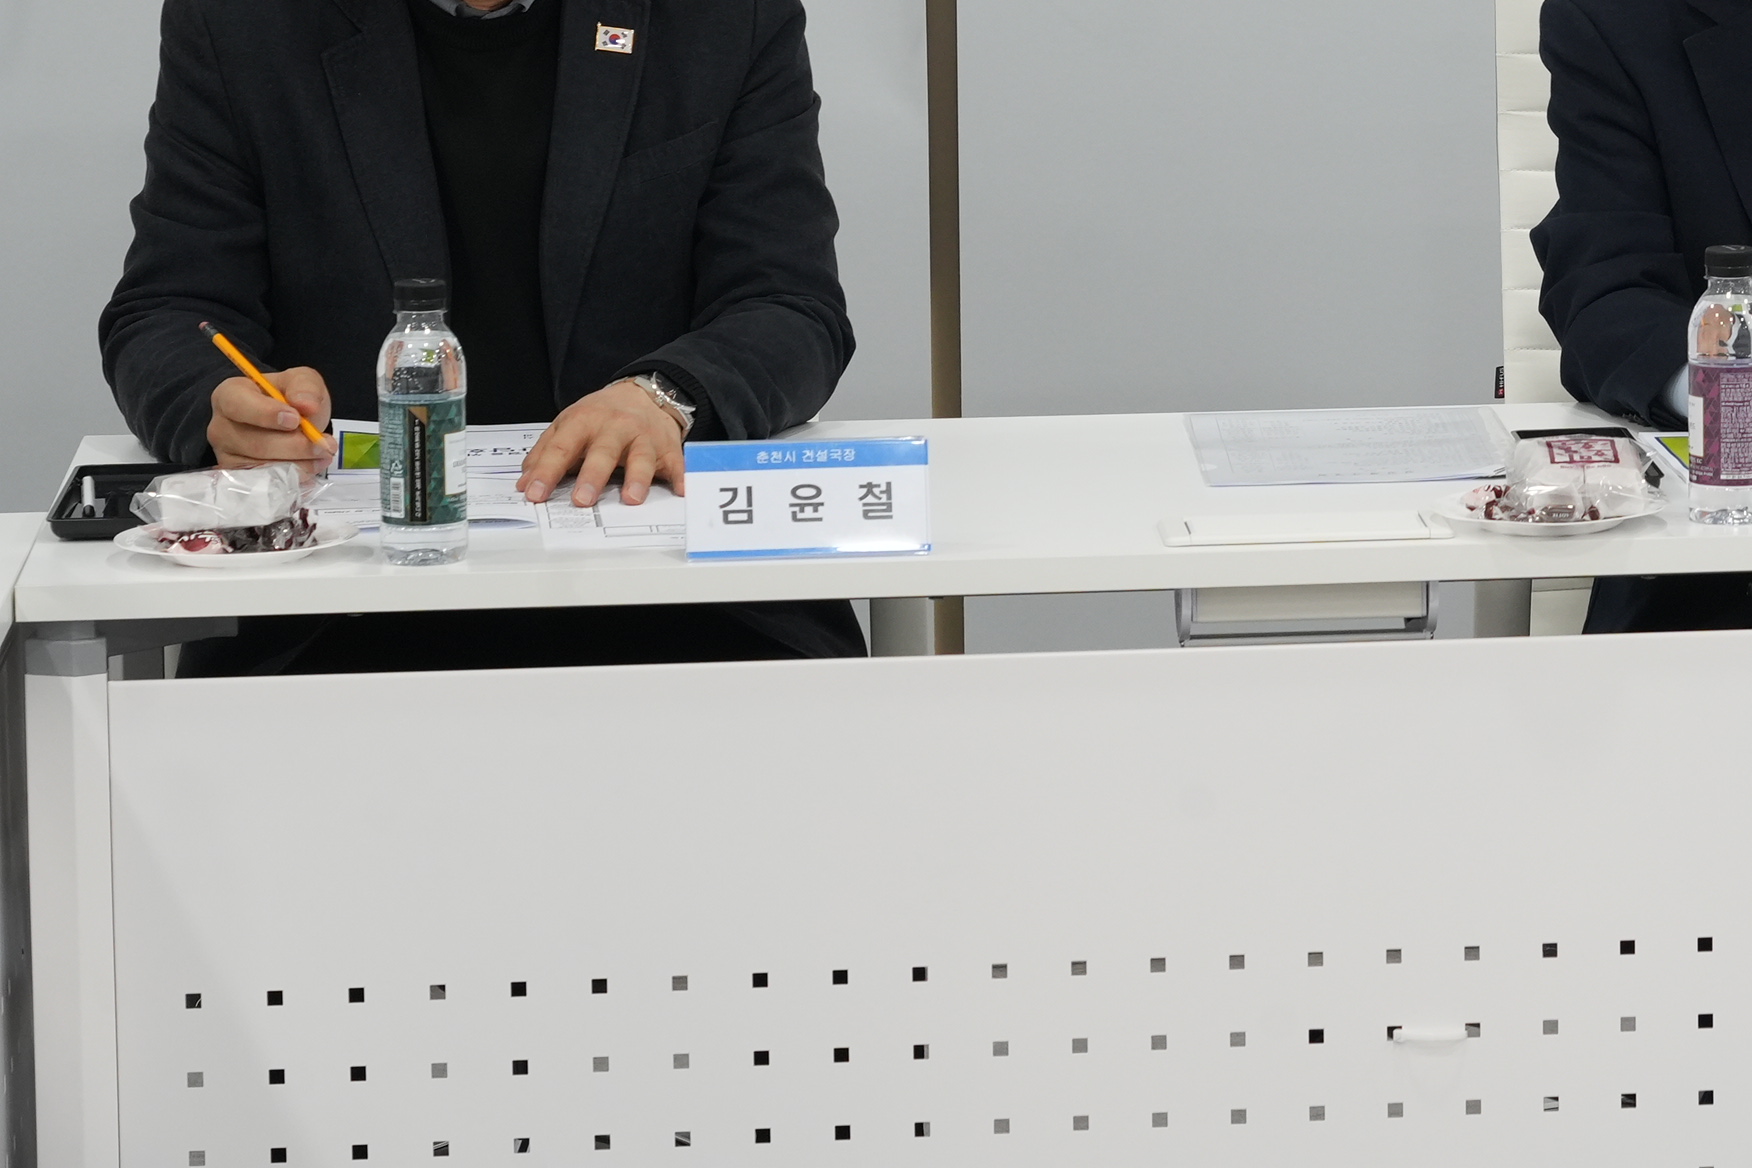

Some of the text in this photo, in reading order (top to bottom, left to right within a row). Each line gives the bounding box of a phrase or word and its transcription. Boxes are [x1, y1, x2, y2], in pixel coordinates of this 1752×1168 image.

[756, 448, 856, 464] 춘천시 건설국장
[718, 480, 894, 525] 김윤철
